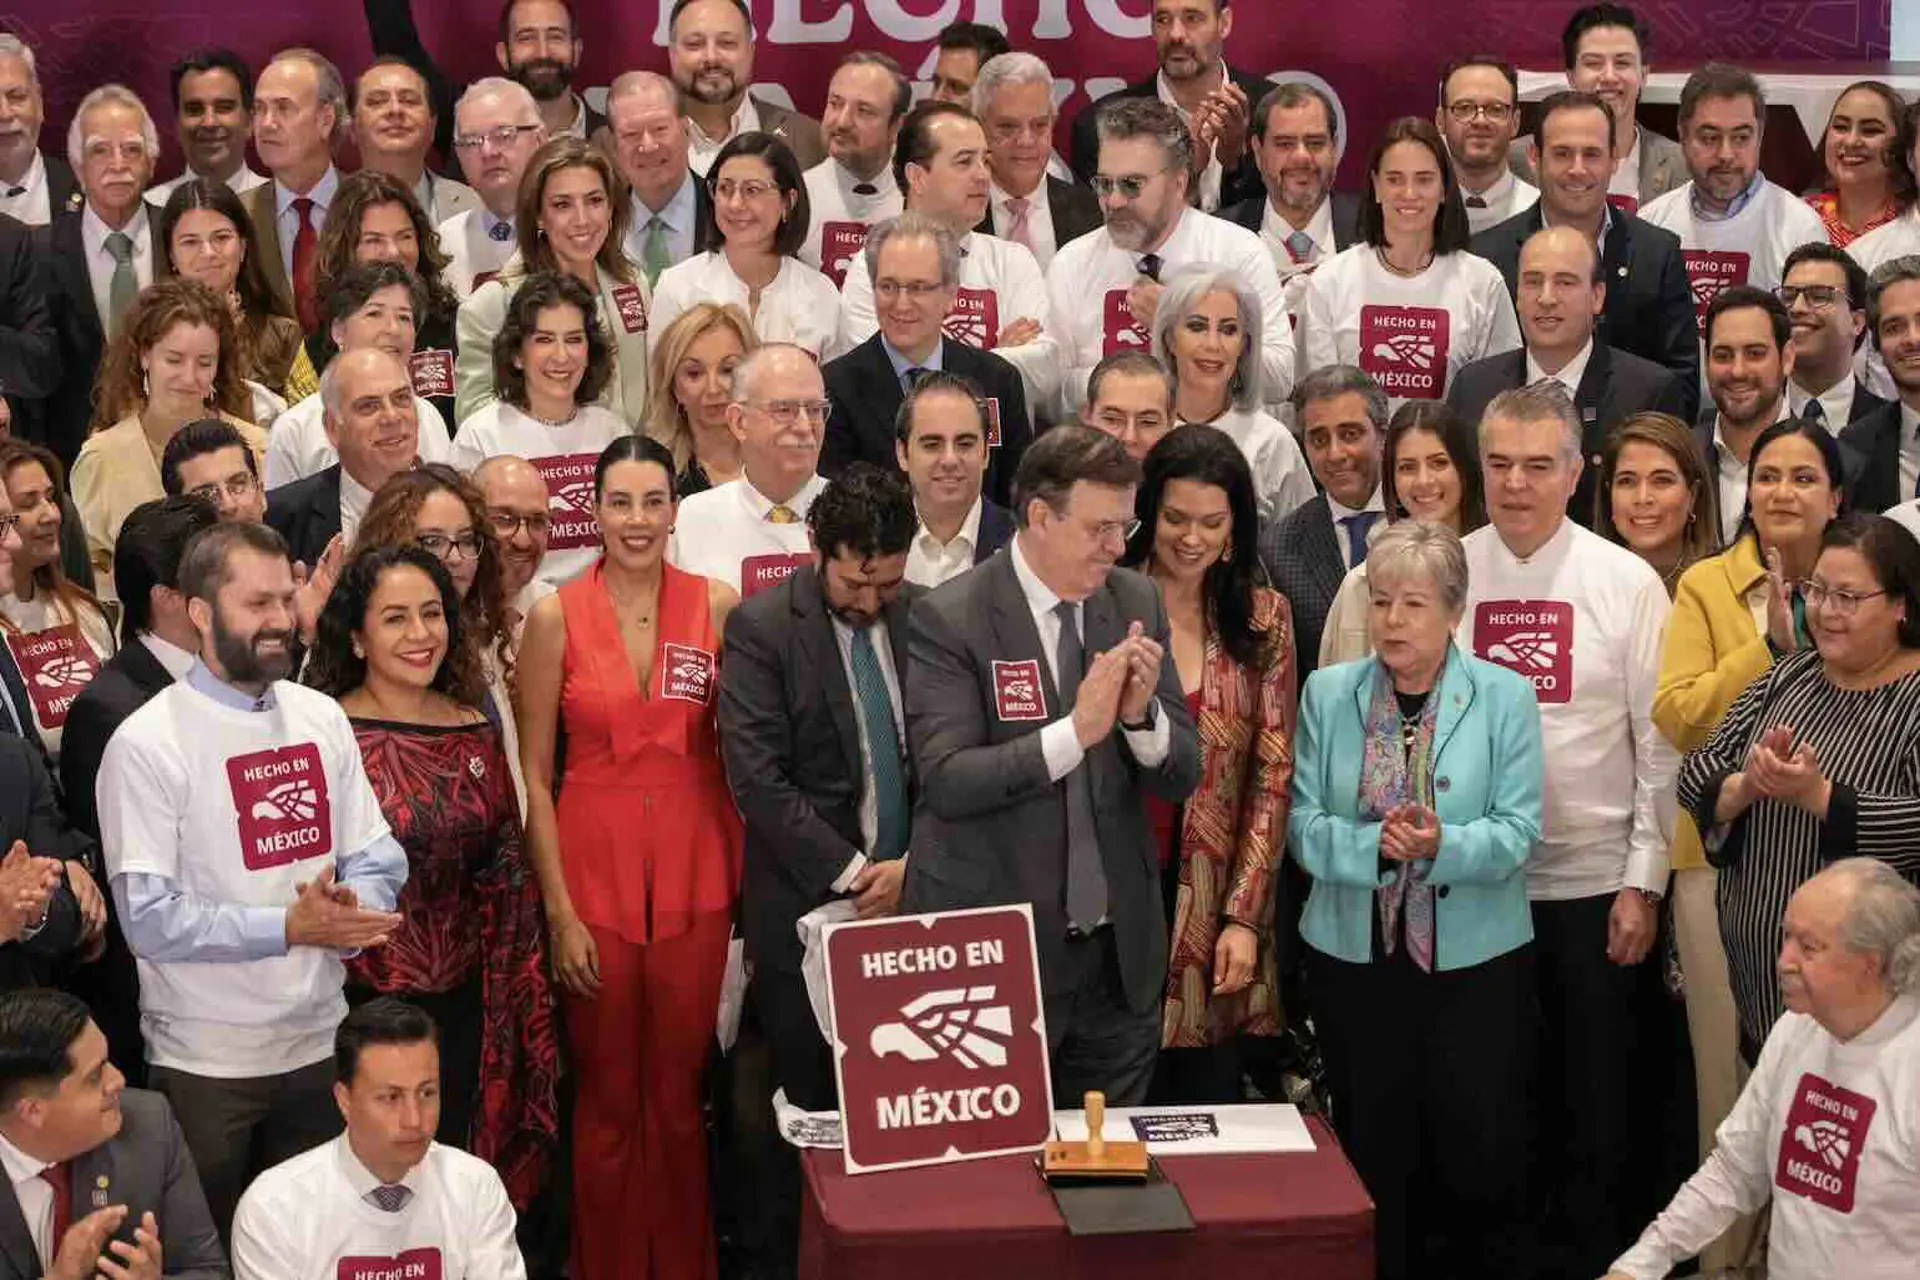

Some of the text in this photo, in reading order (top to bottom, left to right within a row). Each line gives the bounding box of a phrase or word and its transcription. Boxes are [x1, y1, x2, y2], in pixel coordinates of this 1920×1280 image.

[835, 233, 868, 244] HECH
[1721, 262, 1737, 273] EN
[968, 299, 985, 310] EN
[1374, 315, 1436, 330] HECHO EN
[538, 465, 581, 480] HECHO
[551, 520, 600, 540] MÉXIC
[756, 566, 798, 580] HECH
[1489, 612, 1558, 625] HECHO EN
[244, 756, 310, 783] HECHO EN
[256, 827, 320, 856] MÉXICO
[863, 939, 1004, 978] HECHO EN
[877, 1083, 1020, 1130] MÉXICO
[1804, 1089, 1858, 1122] HECHO EN
[1786, 1158, 1843, 1195] MÉXICO
[355, 1263, 425, 1280] HECHO EN
